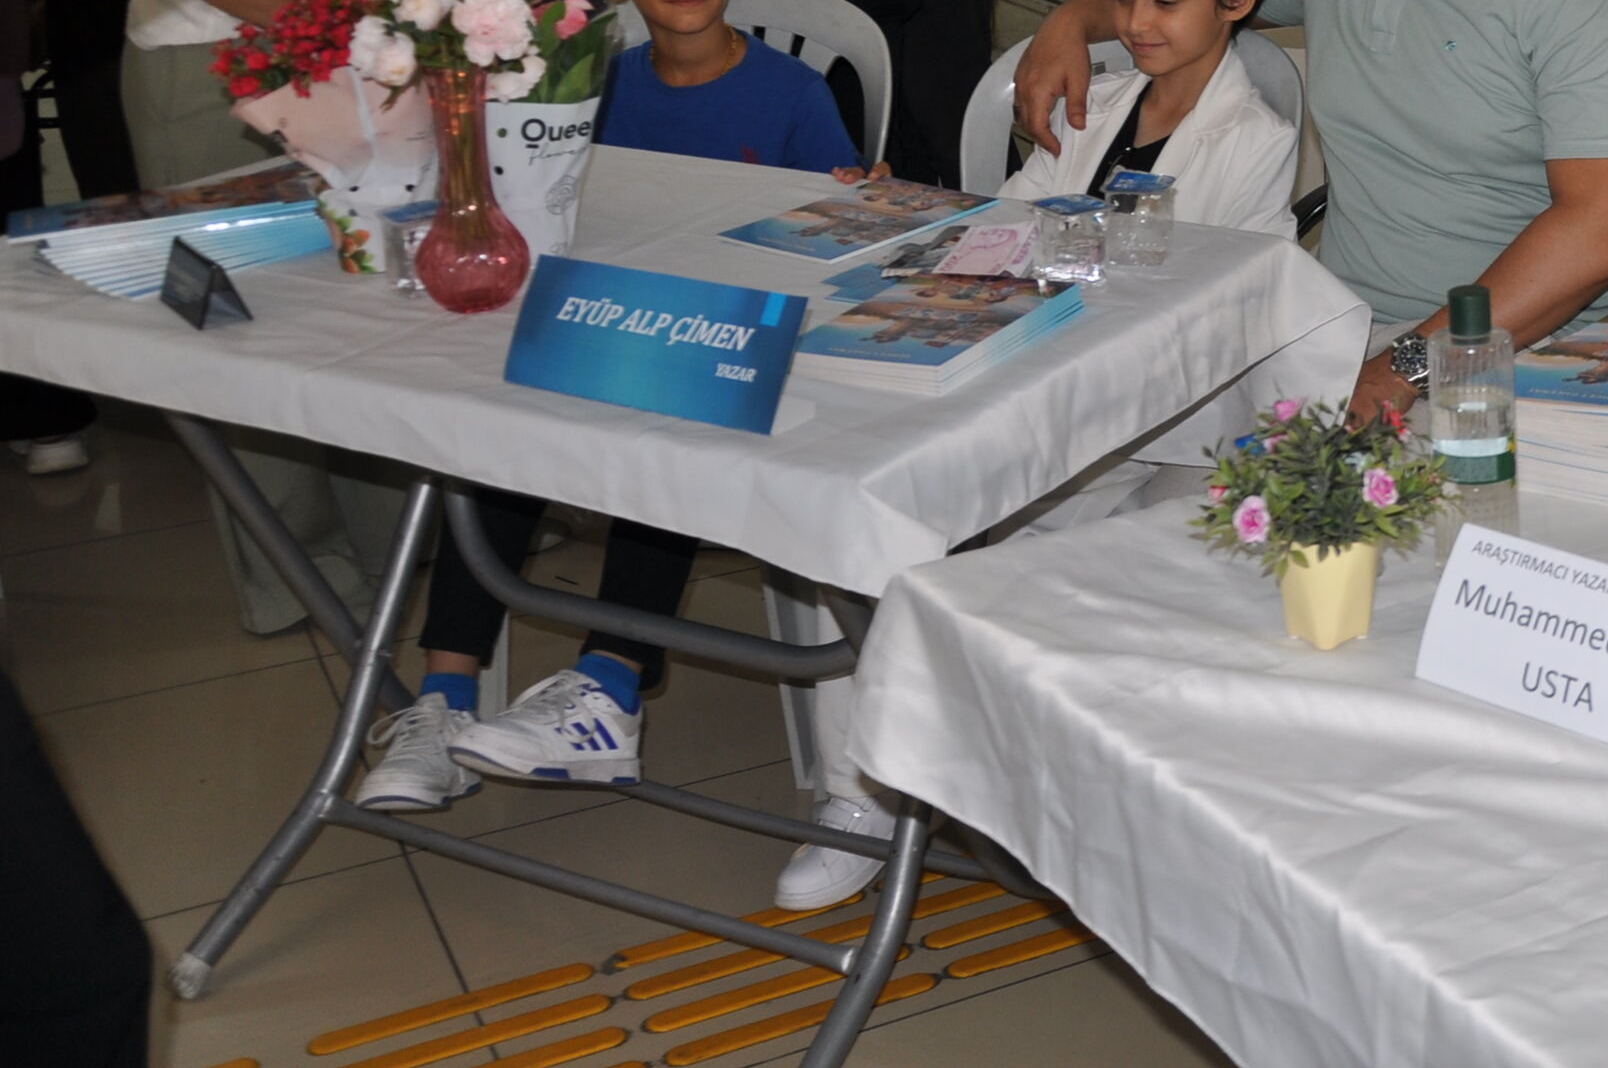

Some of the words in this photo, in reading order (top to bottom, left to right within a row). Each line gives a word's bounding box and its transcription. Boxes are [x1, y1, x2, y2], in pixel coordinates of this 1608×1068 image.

[521, 118, 593, 146] Quee
[556, 296, 624, 328] EYÜP
[617, 307, 674, 336] ALP
[666, 314, 756, 352] ÇİMEN
[714, 363, 759, 383] YAZAR
[1472, 539, 1568, 581] ARAŞTIRMACI
[1521, 661, 1594, 713] USTA
